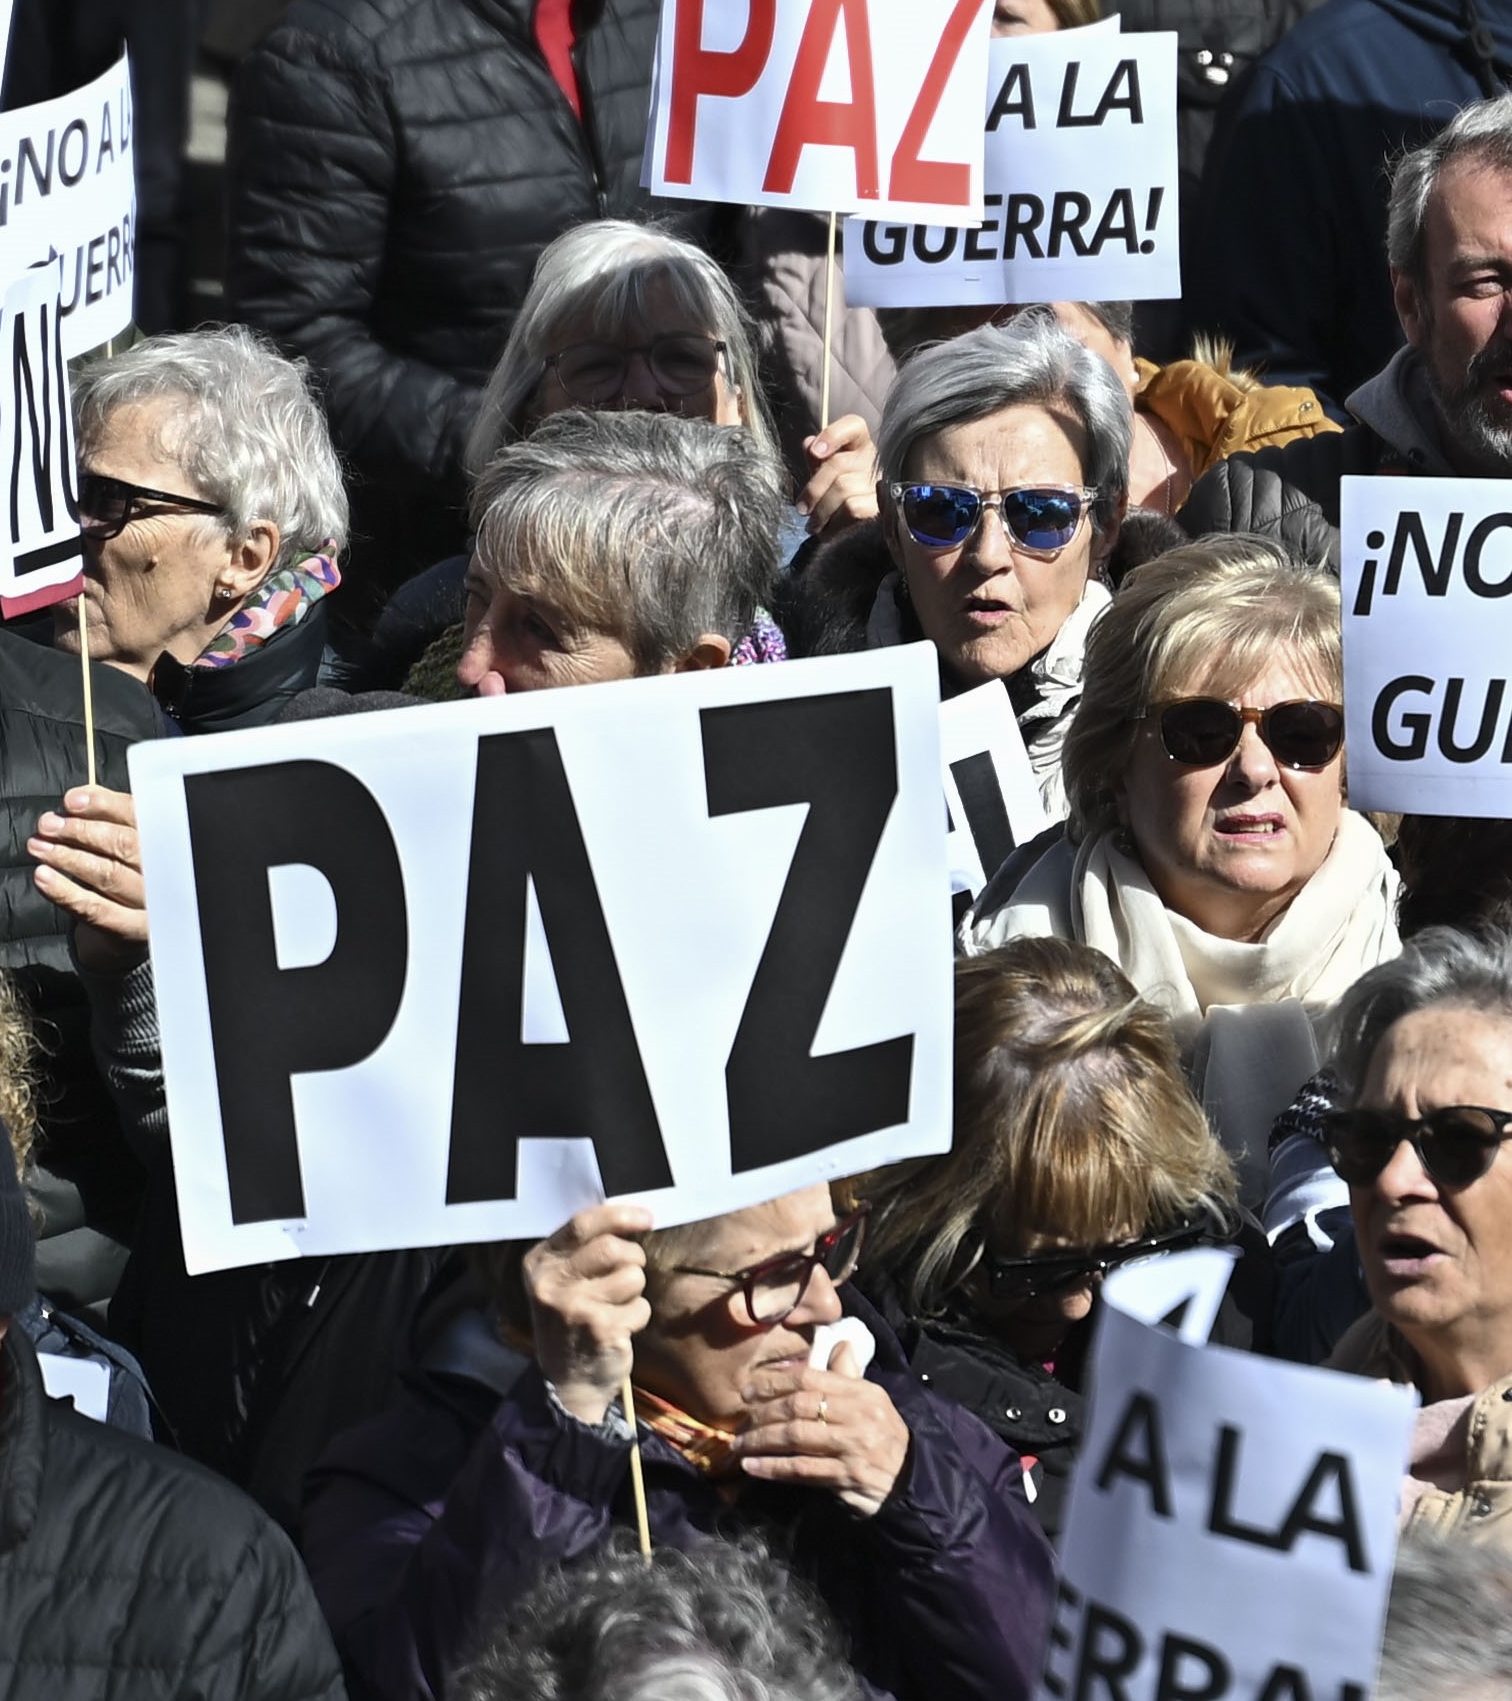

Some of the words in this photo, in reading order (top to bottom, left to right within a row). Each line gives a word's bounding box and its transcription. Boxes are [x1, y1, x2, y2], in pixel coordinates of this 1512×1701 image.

[985, 62, 1038, 131] A
[1055, 58, 1144, 130] LA
[96, 100, 115, 175] A
[862, 186, 1162, 266] GUERRA!
[183, 686, 917, 1226] PAZ
[1094, 1390, 1176, 1521] A
[1204, 1419, 1374, 1575] LA
